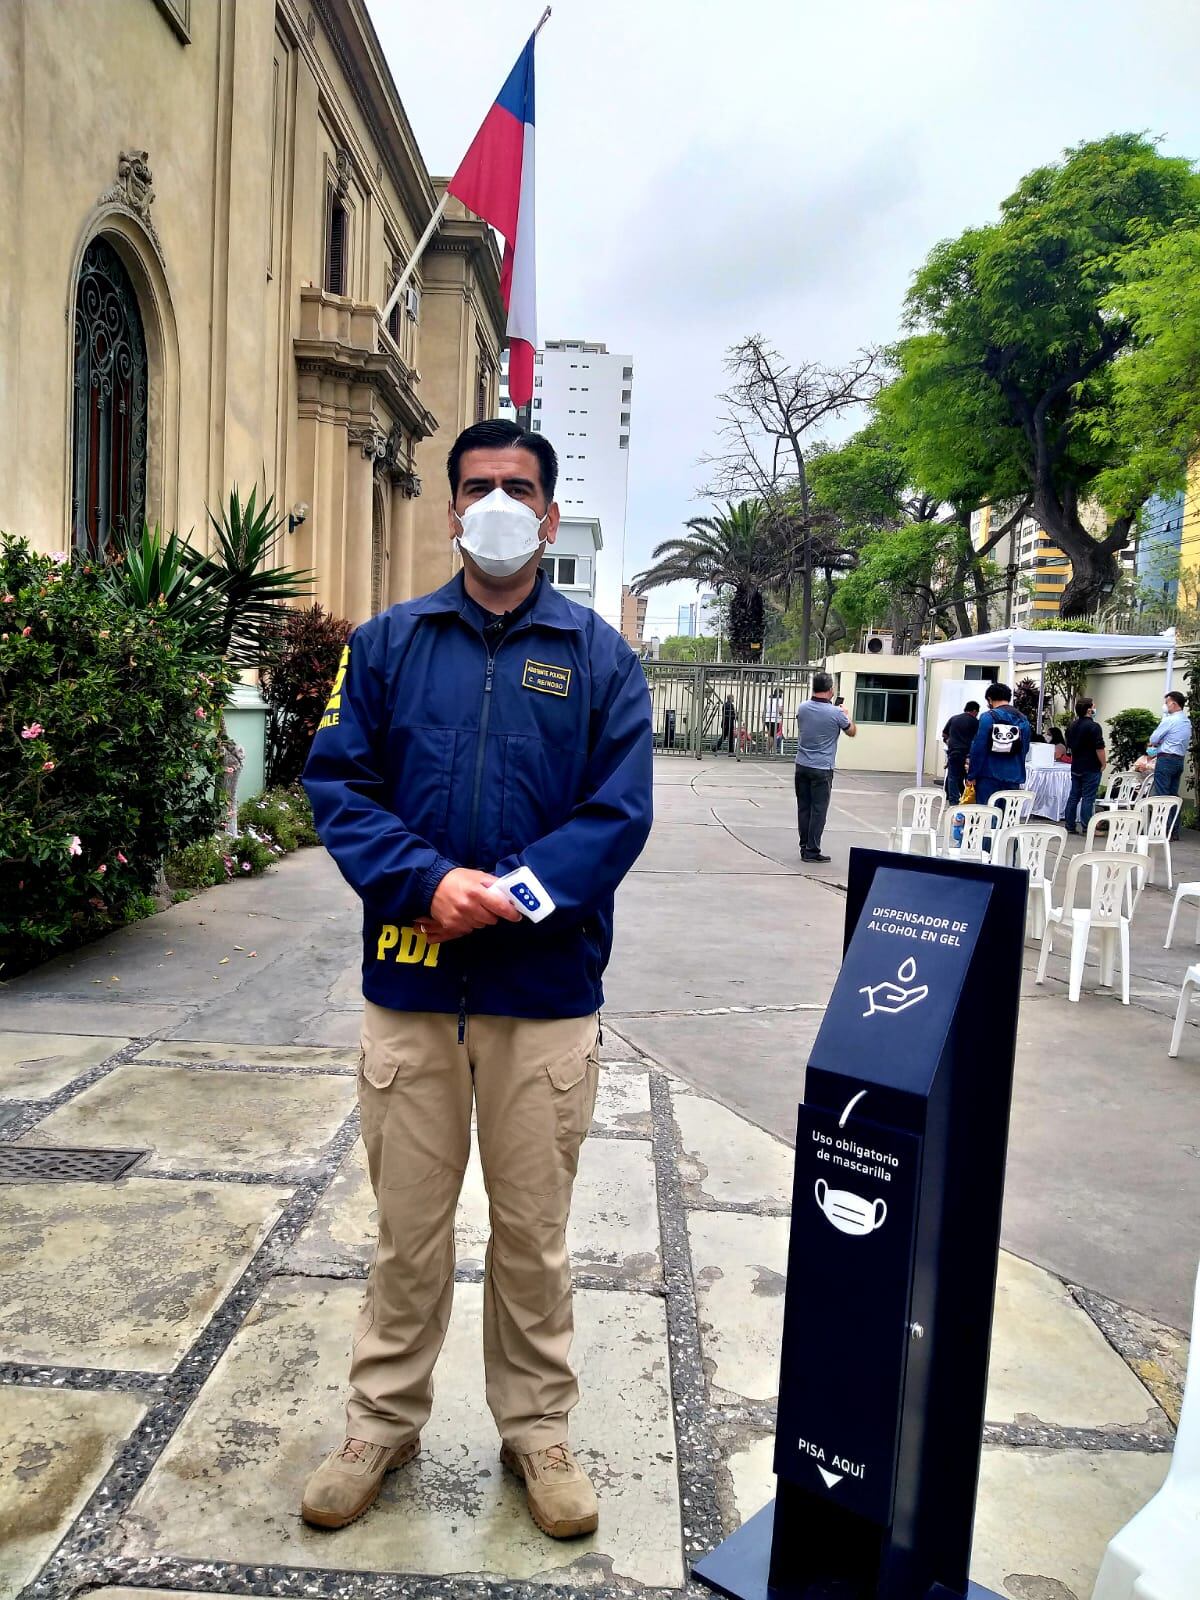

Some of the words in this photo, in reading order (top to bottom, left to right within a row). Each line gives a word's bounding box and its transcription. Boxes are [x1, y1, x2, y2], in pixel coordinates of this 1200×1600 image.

[867, 920, 918, 938] ALCOHOL
[920, 930, 938, 942] EN
[939, 934, 961, 947] GEL
[873, 907, 949, 929] DISPENSADOR
[951, 921, 968, 932] DE
[812, 1130, 833, 1146] Uso
[835, 1138, 900, 1167] obligatorio
[816, 1148, 831, 1161] de
[832, 1154, 892, 1182] mascarilla
[798, 1437, 826, 1462] PISA
[831, 1454, 866, 1479] AQUÍ
